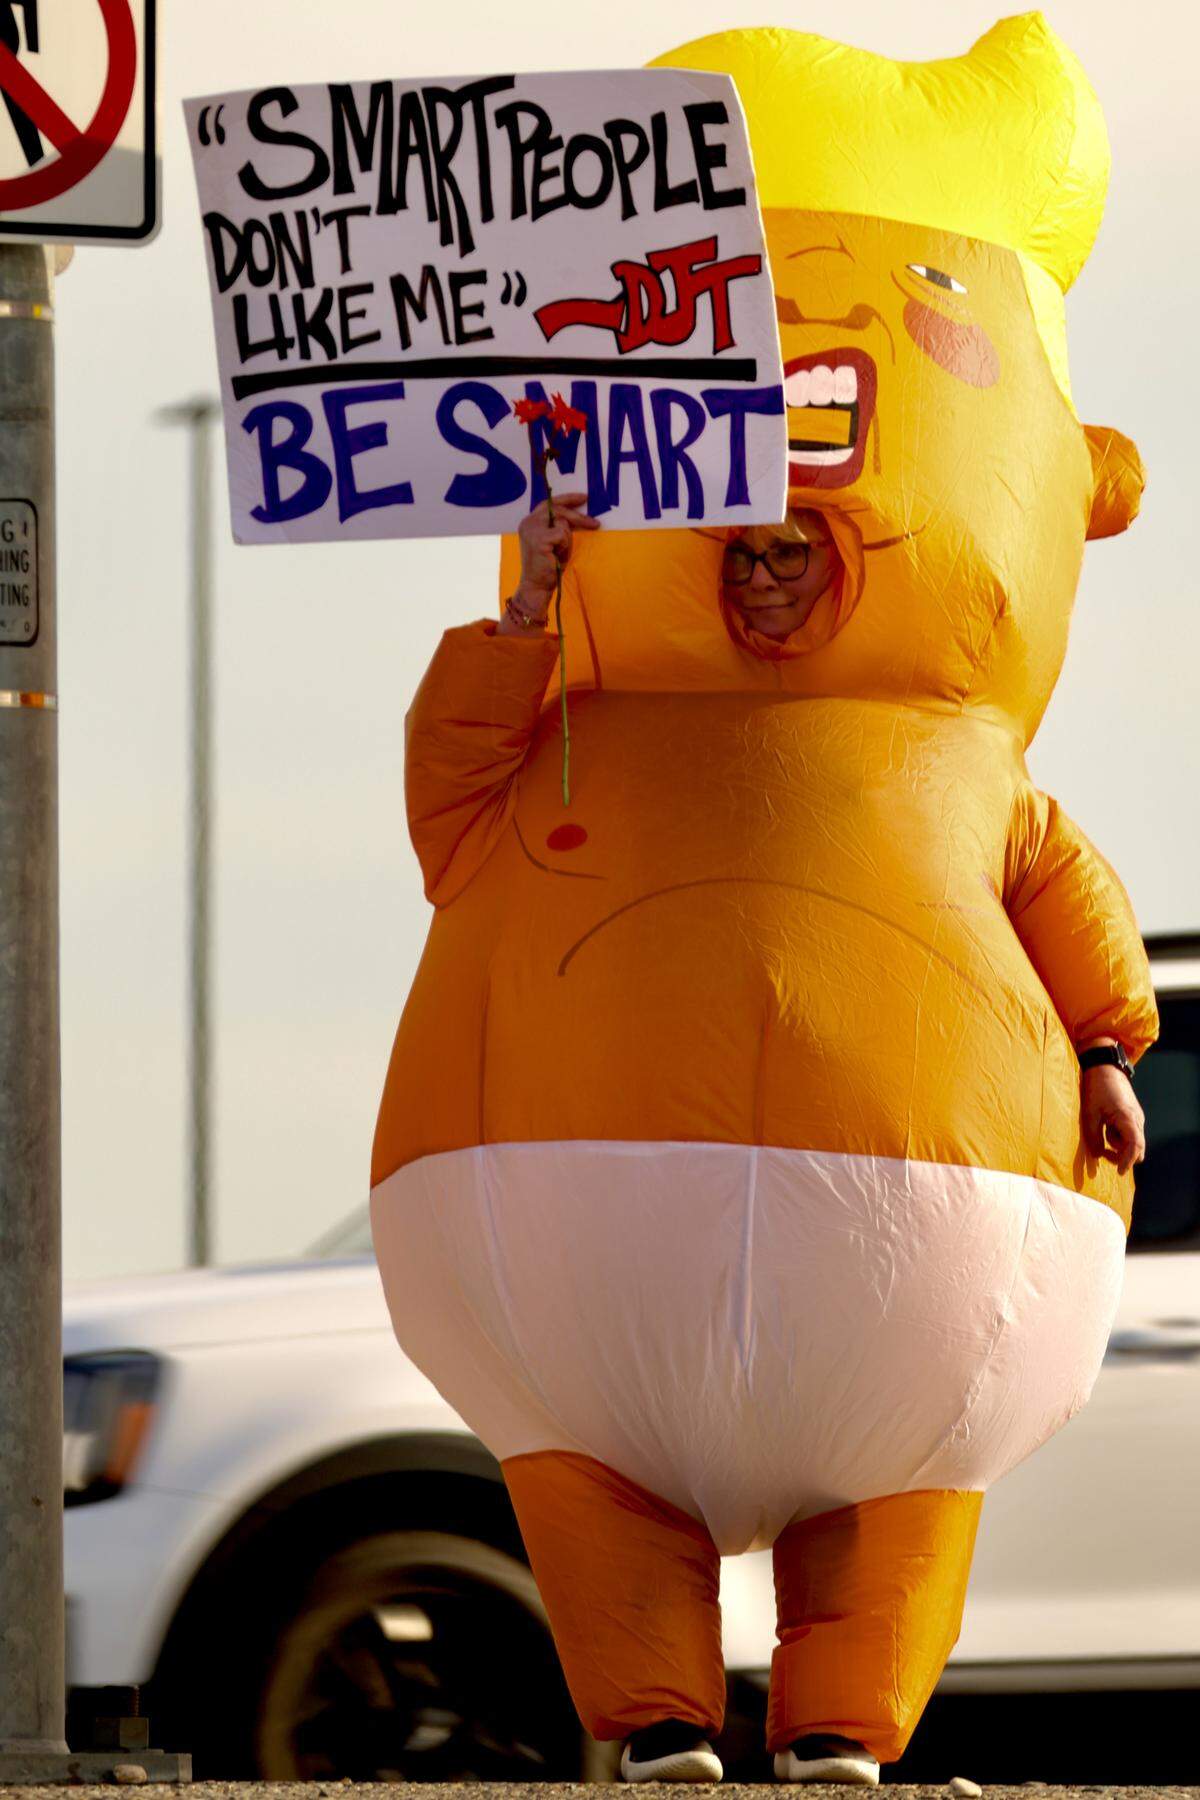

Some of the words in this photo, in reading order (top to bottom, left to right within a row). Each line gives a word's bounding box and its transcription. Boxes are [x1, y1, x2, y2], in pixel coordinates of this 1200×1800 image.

[495, 100, 746, 221] PEOPLE
[203, 205, 371, 292] DON'T
[231, 283, 381, 363] LIKE
[241, 381, 414, 523] BE
[435, 381, 785, 519] SMART
